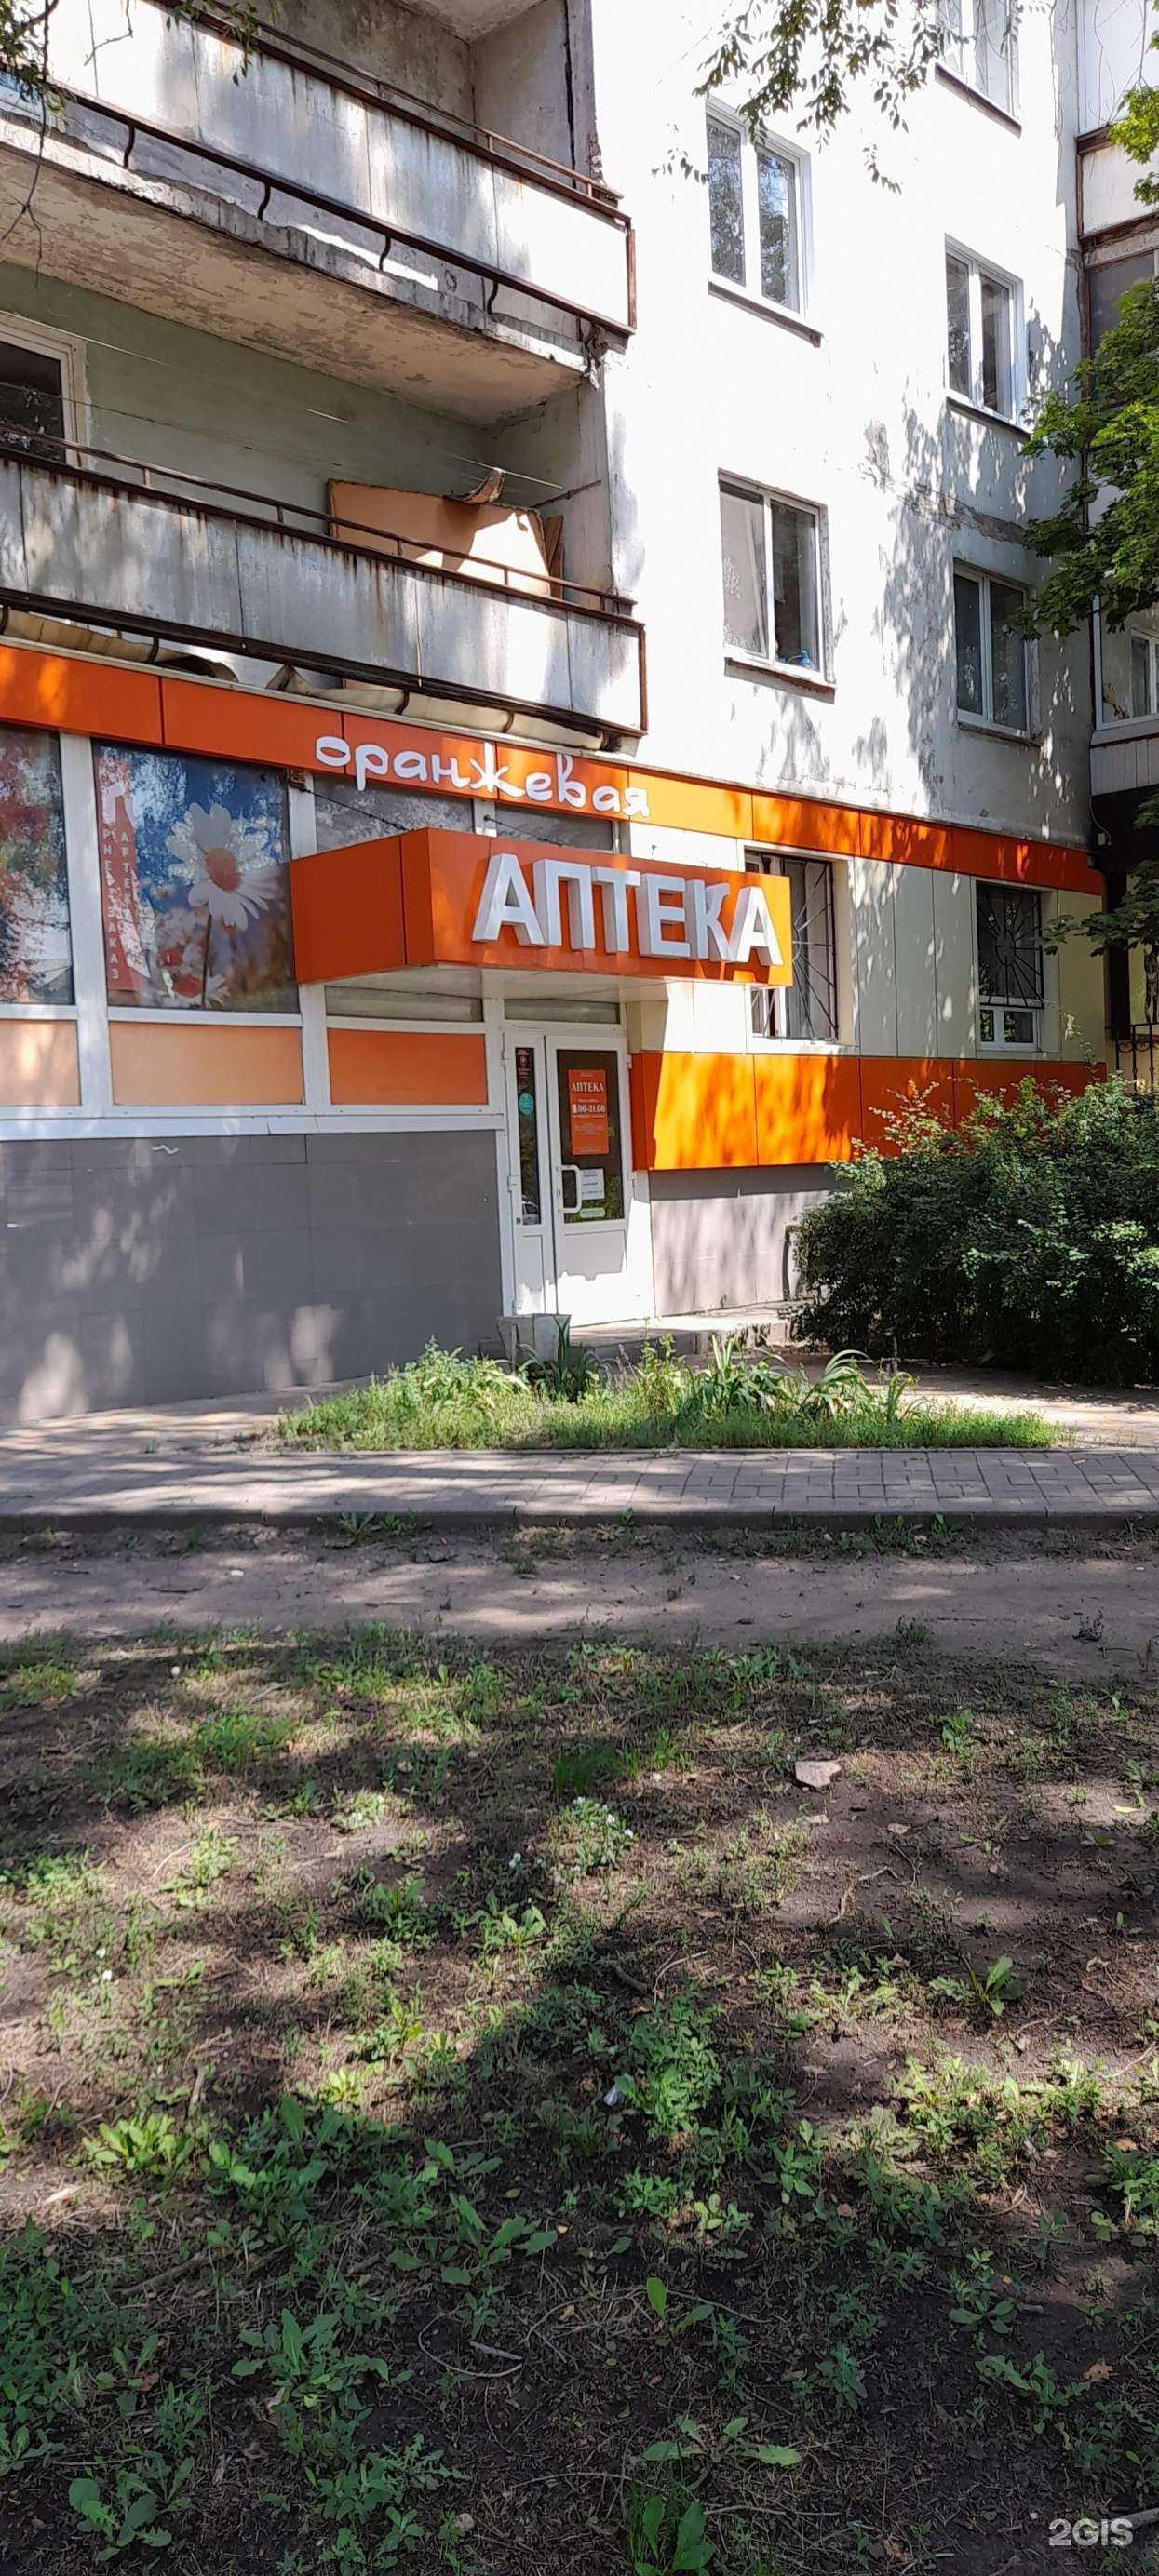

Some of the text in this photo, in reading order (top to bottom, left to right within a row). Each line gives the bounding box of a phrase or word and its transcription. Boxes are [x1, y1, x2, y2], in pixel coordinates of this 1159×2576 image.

[315, 735, 650, 819] оранжевая
[471, 853, 784, 966] АПТЕКА
[572, 1081, 604, 1093] АПТЕКА
